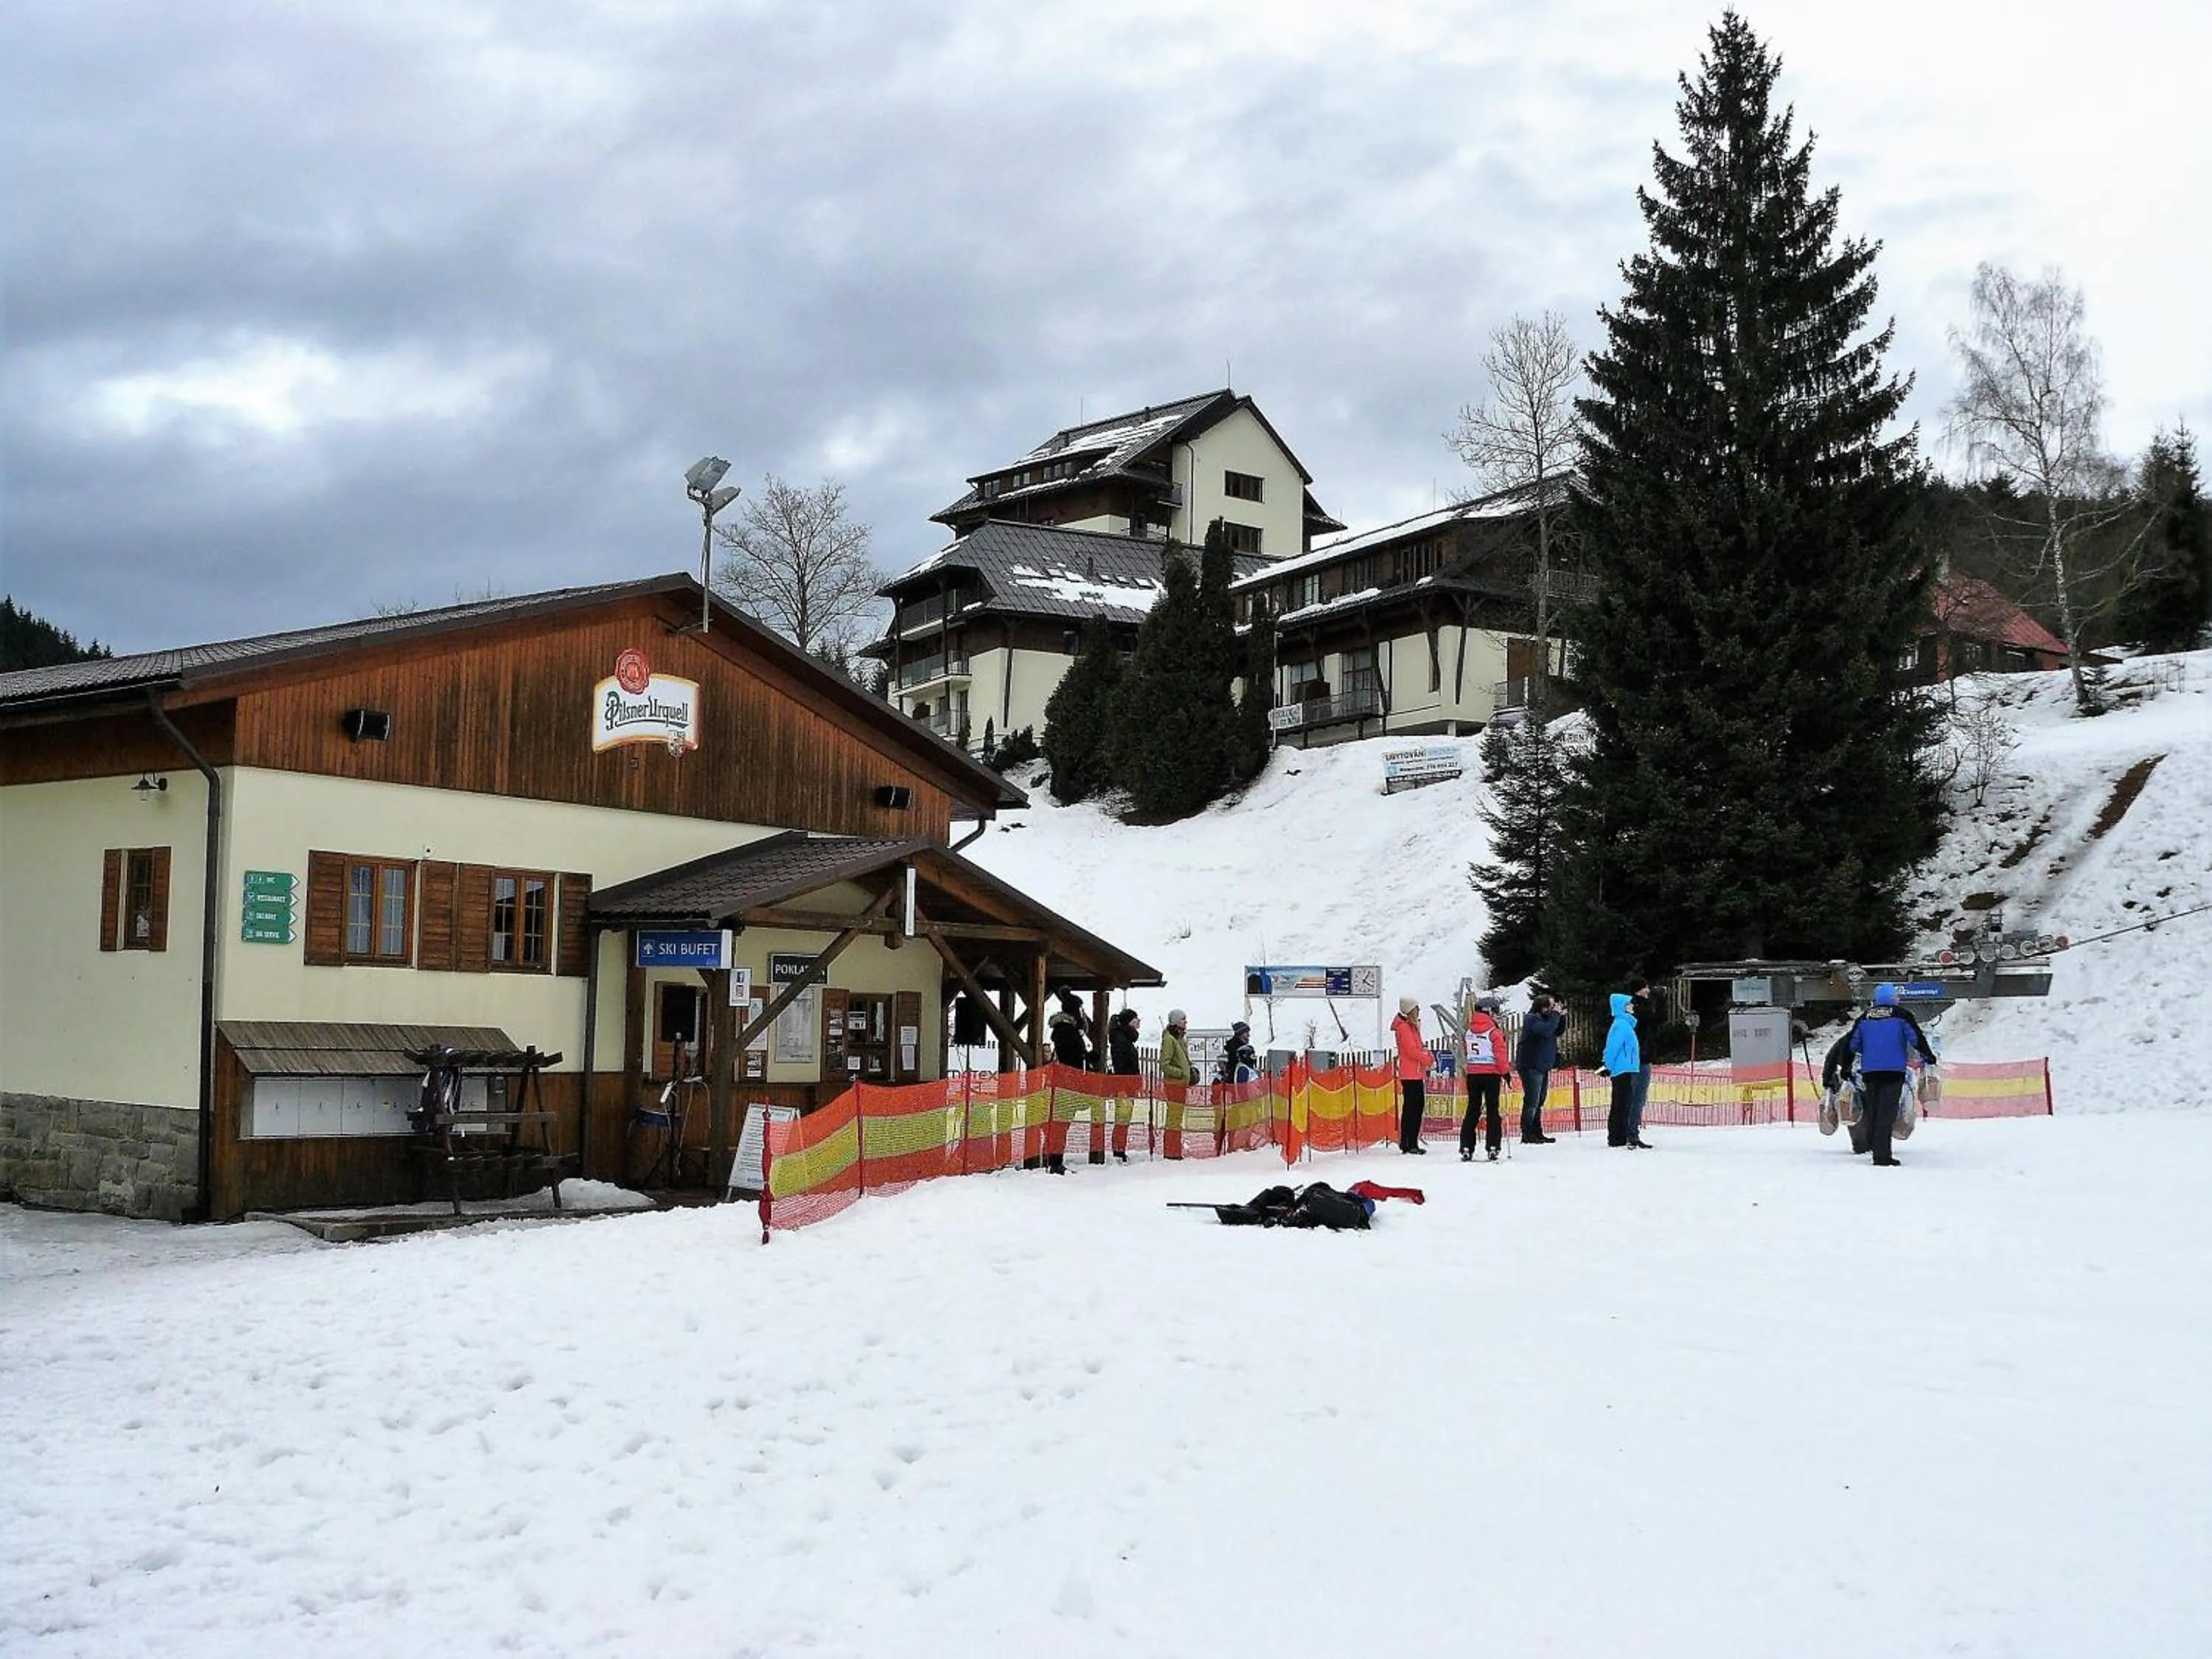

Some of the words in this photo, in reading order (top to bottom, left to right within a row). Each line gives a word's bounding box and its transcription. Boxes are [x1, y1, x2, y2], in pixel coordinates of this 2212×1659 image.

[605, 691, 649, 730] Pilsner
[648, 695, 689, 727] Urquell
[658, 943, 677, 955] SKI
[681, 943, 718, 956] BUFET
[775, 963, 826, 975] POKLA
[1471, 1043, 1480, 1055] 5
